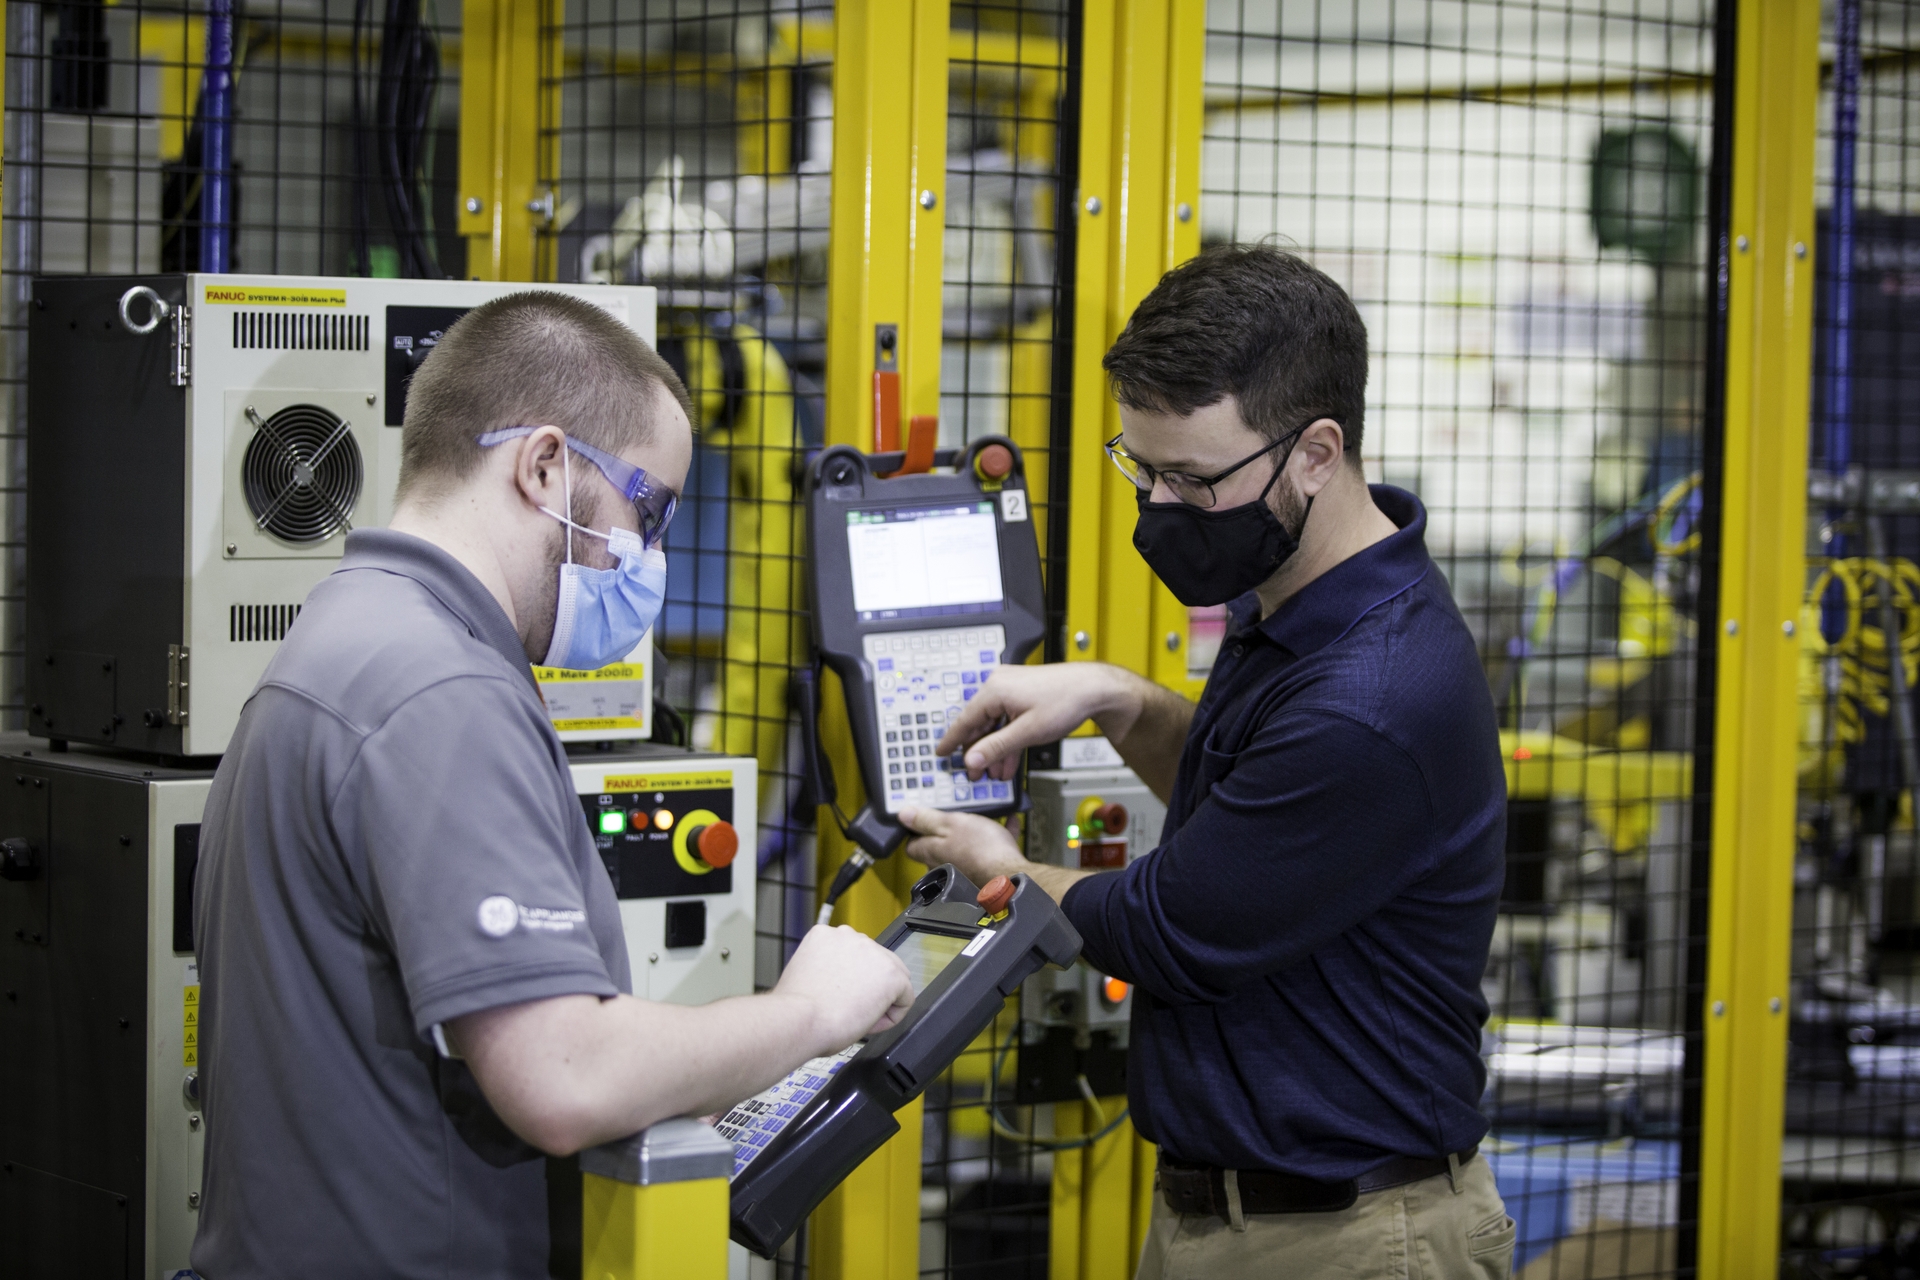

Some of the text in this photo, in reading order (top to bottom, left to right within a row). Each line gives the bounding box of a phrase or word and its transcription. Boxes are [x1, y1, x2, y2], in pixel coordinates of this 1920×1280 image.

[206, 291, 246, 301] FANUC
[1008, 496, 1021, 515] 2
[538, 670, 554, 679] LR
[560, 670, 588, 679] Mate
[606, 779, 648, 789] FANUC
